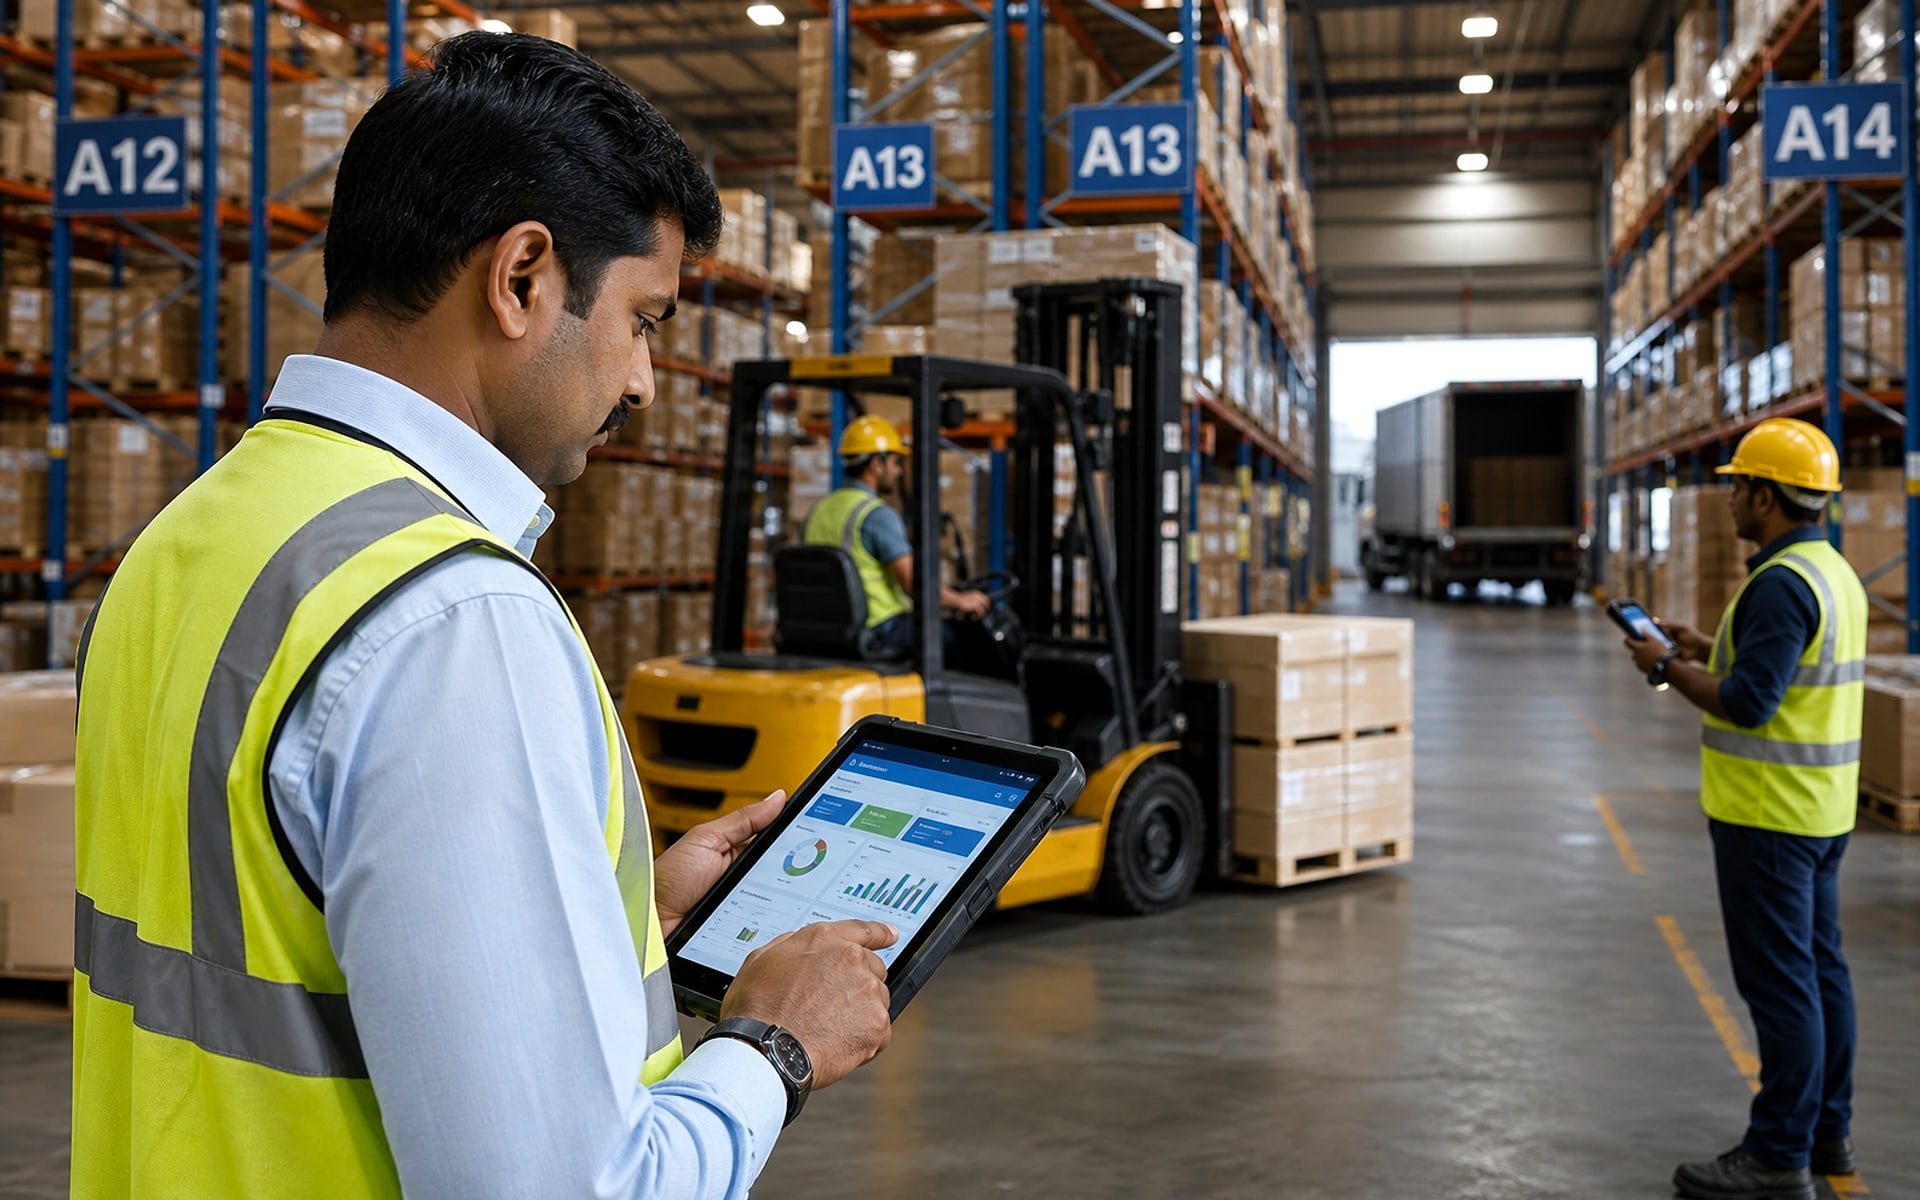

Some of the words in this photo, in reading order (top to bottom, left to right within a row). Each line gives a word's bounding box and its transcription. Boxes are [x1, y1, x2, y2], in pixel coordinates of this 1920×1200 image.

[1079, 124, 1182, 178] A13
[1775, 102, 1897, 162] A14
[64, 137, 178, 196] A12
[843, 145, 926, 191] A13
